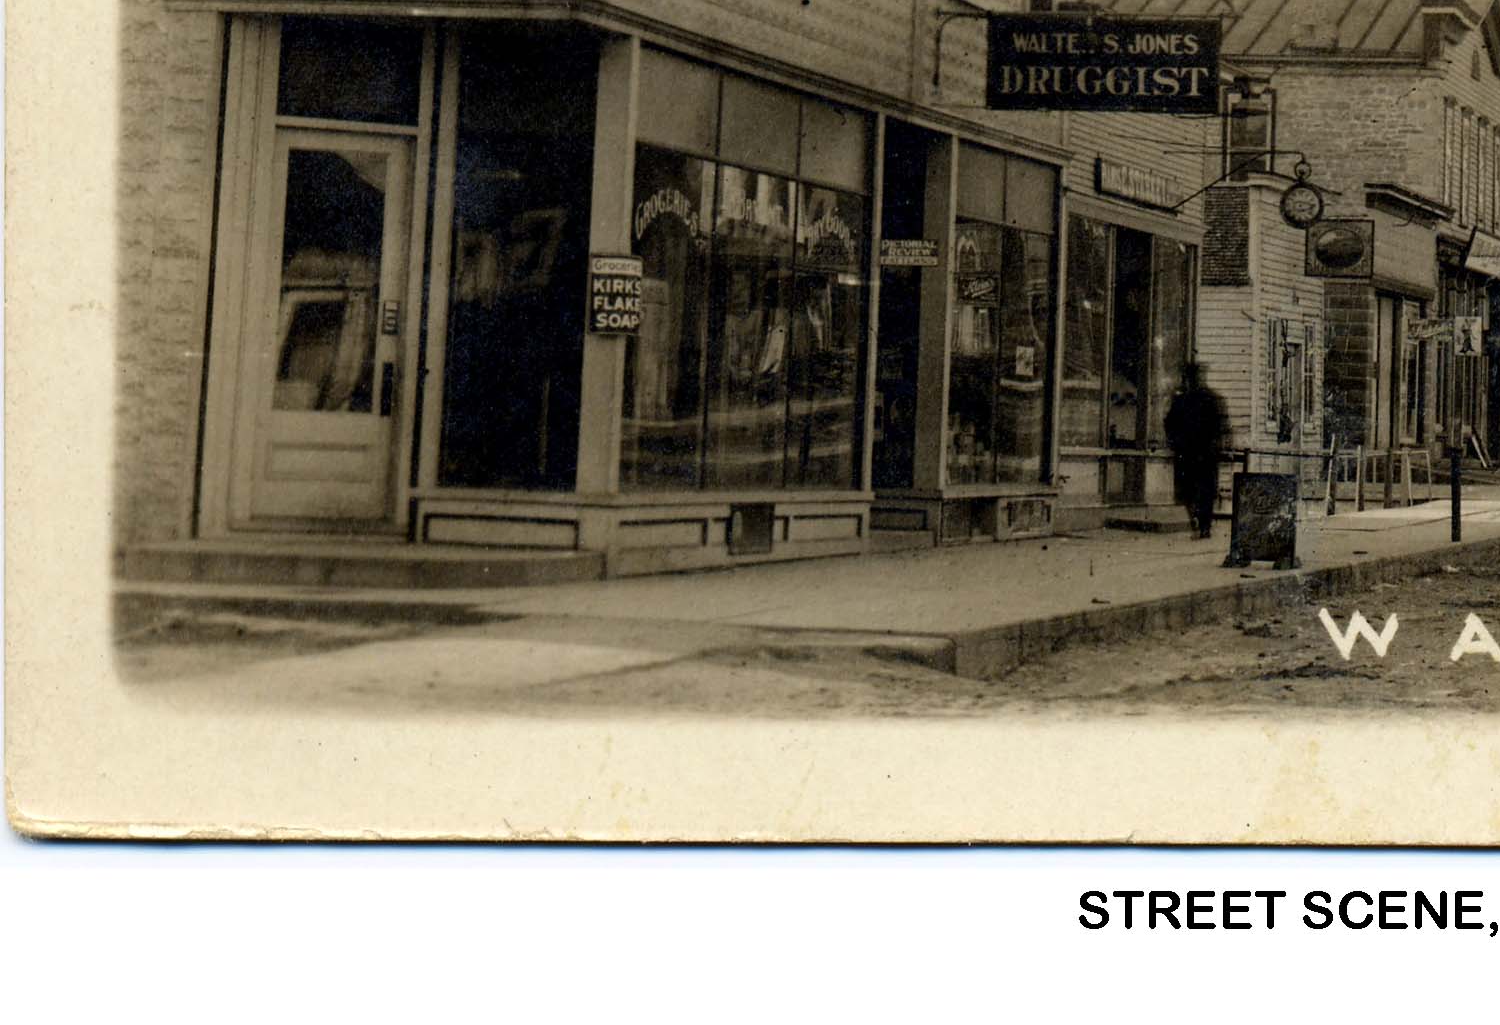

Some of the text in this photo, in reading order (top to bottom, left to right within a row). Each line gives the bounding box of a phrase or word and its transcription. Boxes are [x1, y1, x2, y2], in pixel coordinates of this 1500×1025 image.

[1012, 32, 1096, 54] WALTE
[1128, 33, 1199, 55] JONES
[998, 65, 1209, 97] DRUGGIST
[881, 238, 937, 250] PICTORIAL
[888, 247, 931, 256] REVIEW
[592, 278, 641, 294] KIRKS
[593, 296, 641, 311] FLAKE
[595, 312, 641, 328] SOAP
